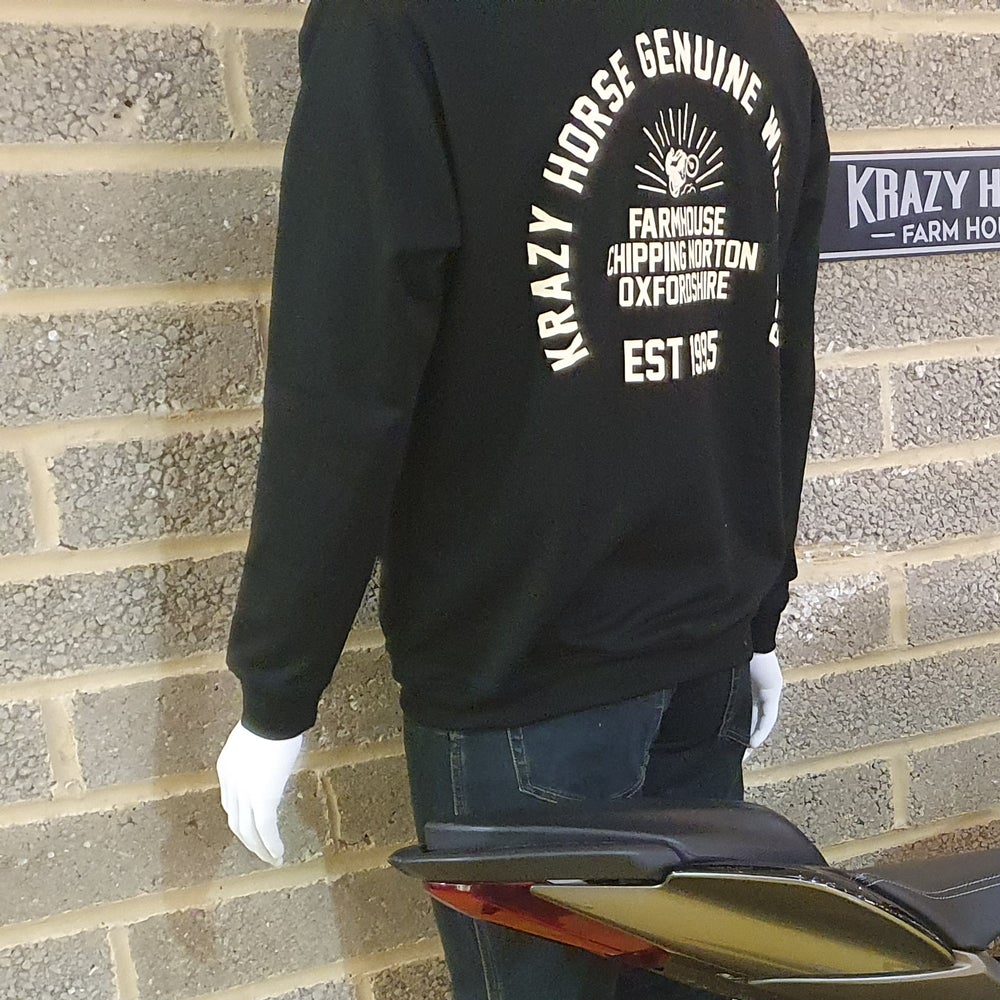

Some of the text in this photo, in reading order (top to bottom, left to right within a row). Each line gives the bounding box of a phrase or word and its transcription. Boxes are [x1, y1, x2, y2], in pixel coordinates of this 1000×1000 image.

[634, 28, 762, 116] GENUINE
[543, 48, 636, 194] HORSE
[628, 205, 727, 240] FARMHOUSE
[847, 164, 970, 229] KRAZY
[606, 238, 760, 277] CHIPPING NORTON
[902, 218, 959, 244] FARM
[527, 204, 590, 373] KRAZY
[618, 270, 731, 308] OXFORDSHIRE
[623, 329, 719, 383] EST 1995
